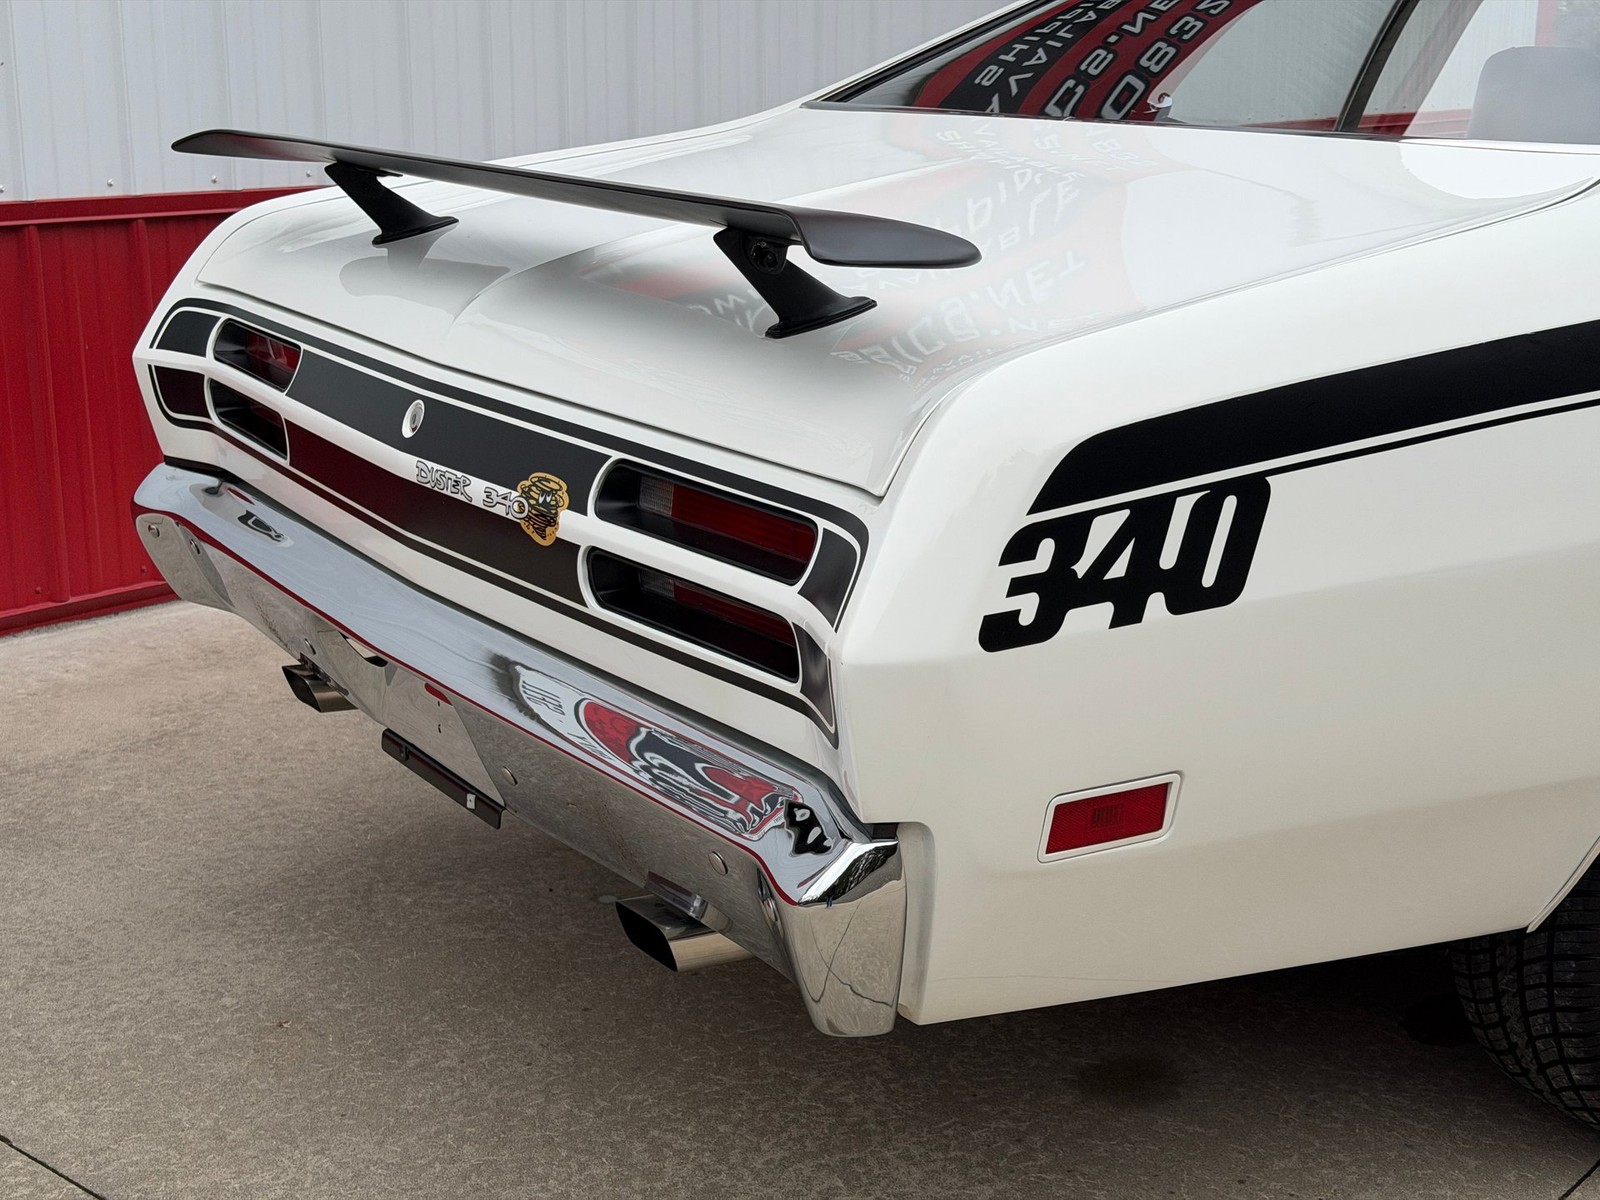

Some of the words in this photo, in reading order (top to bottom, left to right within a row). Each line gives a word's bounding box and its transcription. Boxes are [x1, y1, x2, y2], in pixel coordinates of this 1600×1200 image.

[415, 459, 473, 503] DUSTER
[482, 486, 529, 520] 340
[978, 475, 1272, 653] 340
